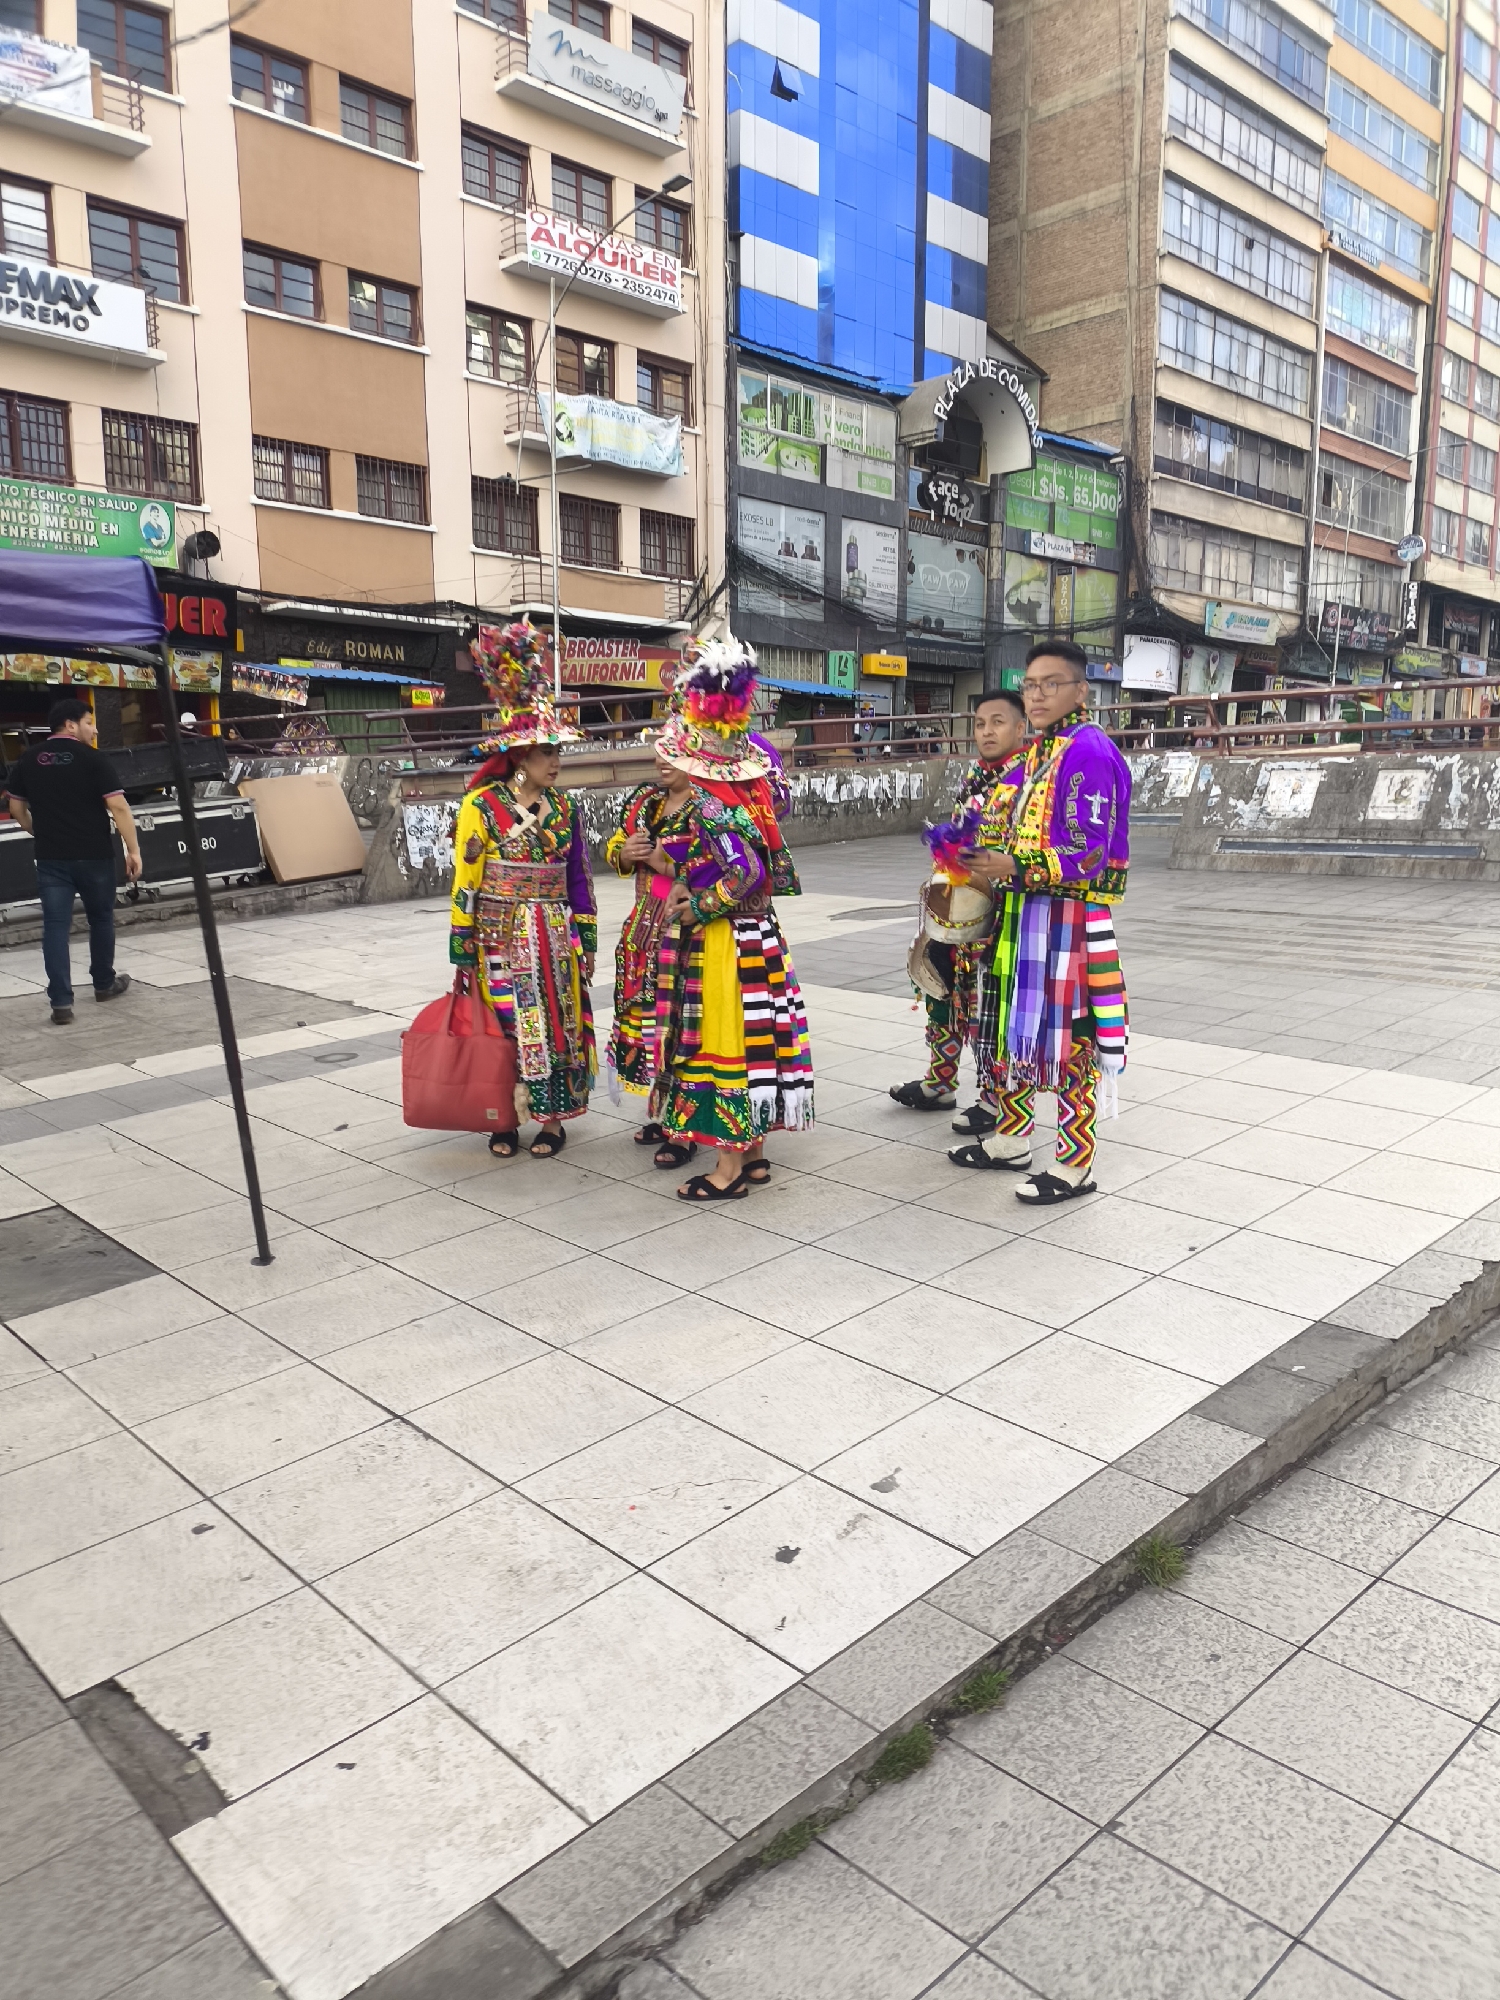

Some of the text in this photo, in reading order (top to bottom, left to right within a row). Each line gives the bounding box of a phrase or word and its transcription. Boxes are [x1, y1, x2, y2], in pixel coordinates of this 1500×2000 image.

[571, 64, 656, 111] massaggio
[654, 107, 669, 122] Spa
[529, 210, 678, 272] OFICINAS EN
[530, 226, 678, 289] ALQUILER
[543, 251, 613, 284] 77260275
[622, 277, 677, 305] 2352474
[934, 357, 1043, 450] PLAZA DE COMIDAS
[824, 414, 865, 437] Vvero
[0, 483, 138, 512] TO TÉCNICO EN SALUD
[928, 480, 959, 502] face
[1073, 484, 1117, 513] 65.000
[42, 502, 70, 515] RITA
[943, 495, 975, 522] food
[0, 523, 100, 548] ENFERMERIA
[45, 515, 96, 533] MEDIO
[101, 522, 120, 536] EN
[1047, 542, 1065, 552] PLAZA
[922, 573, 940, 585] PAW
[948, 577, 966, 589] PAW
[306, 639, 405, 661] Edy ROMAN
[565, 637, 641, 660] BROASTER
[559, 660, 647, 684] CALIFORNIA
